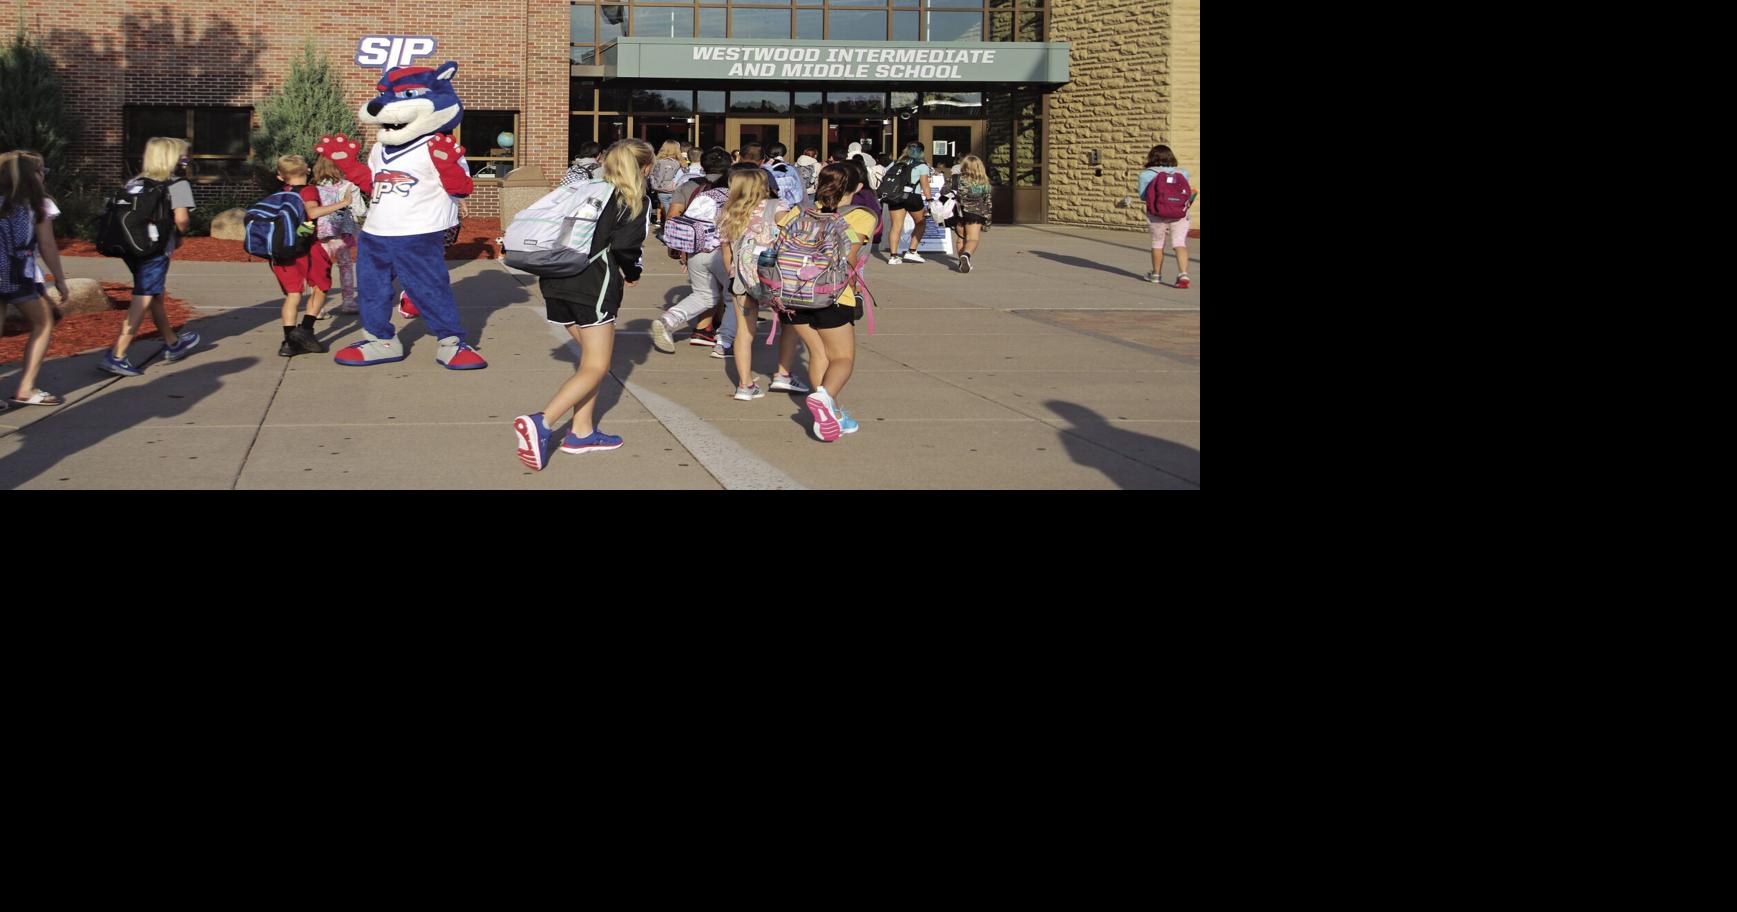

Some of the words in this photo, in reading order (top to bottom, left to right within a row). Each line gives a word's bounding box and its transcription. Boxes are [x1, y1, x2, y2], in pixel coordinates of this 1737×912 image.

[692, 46, 820, 62] WESTWOOD
[826, 48, 996, 64] INTERMEDIATE
[728, 62, 776, 77] AND
[781, 63, 870, 78] MIDDLE
[875, 64, 962, 79] SCHOOL
[948, 141, 956, 157] 1
